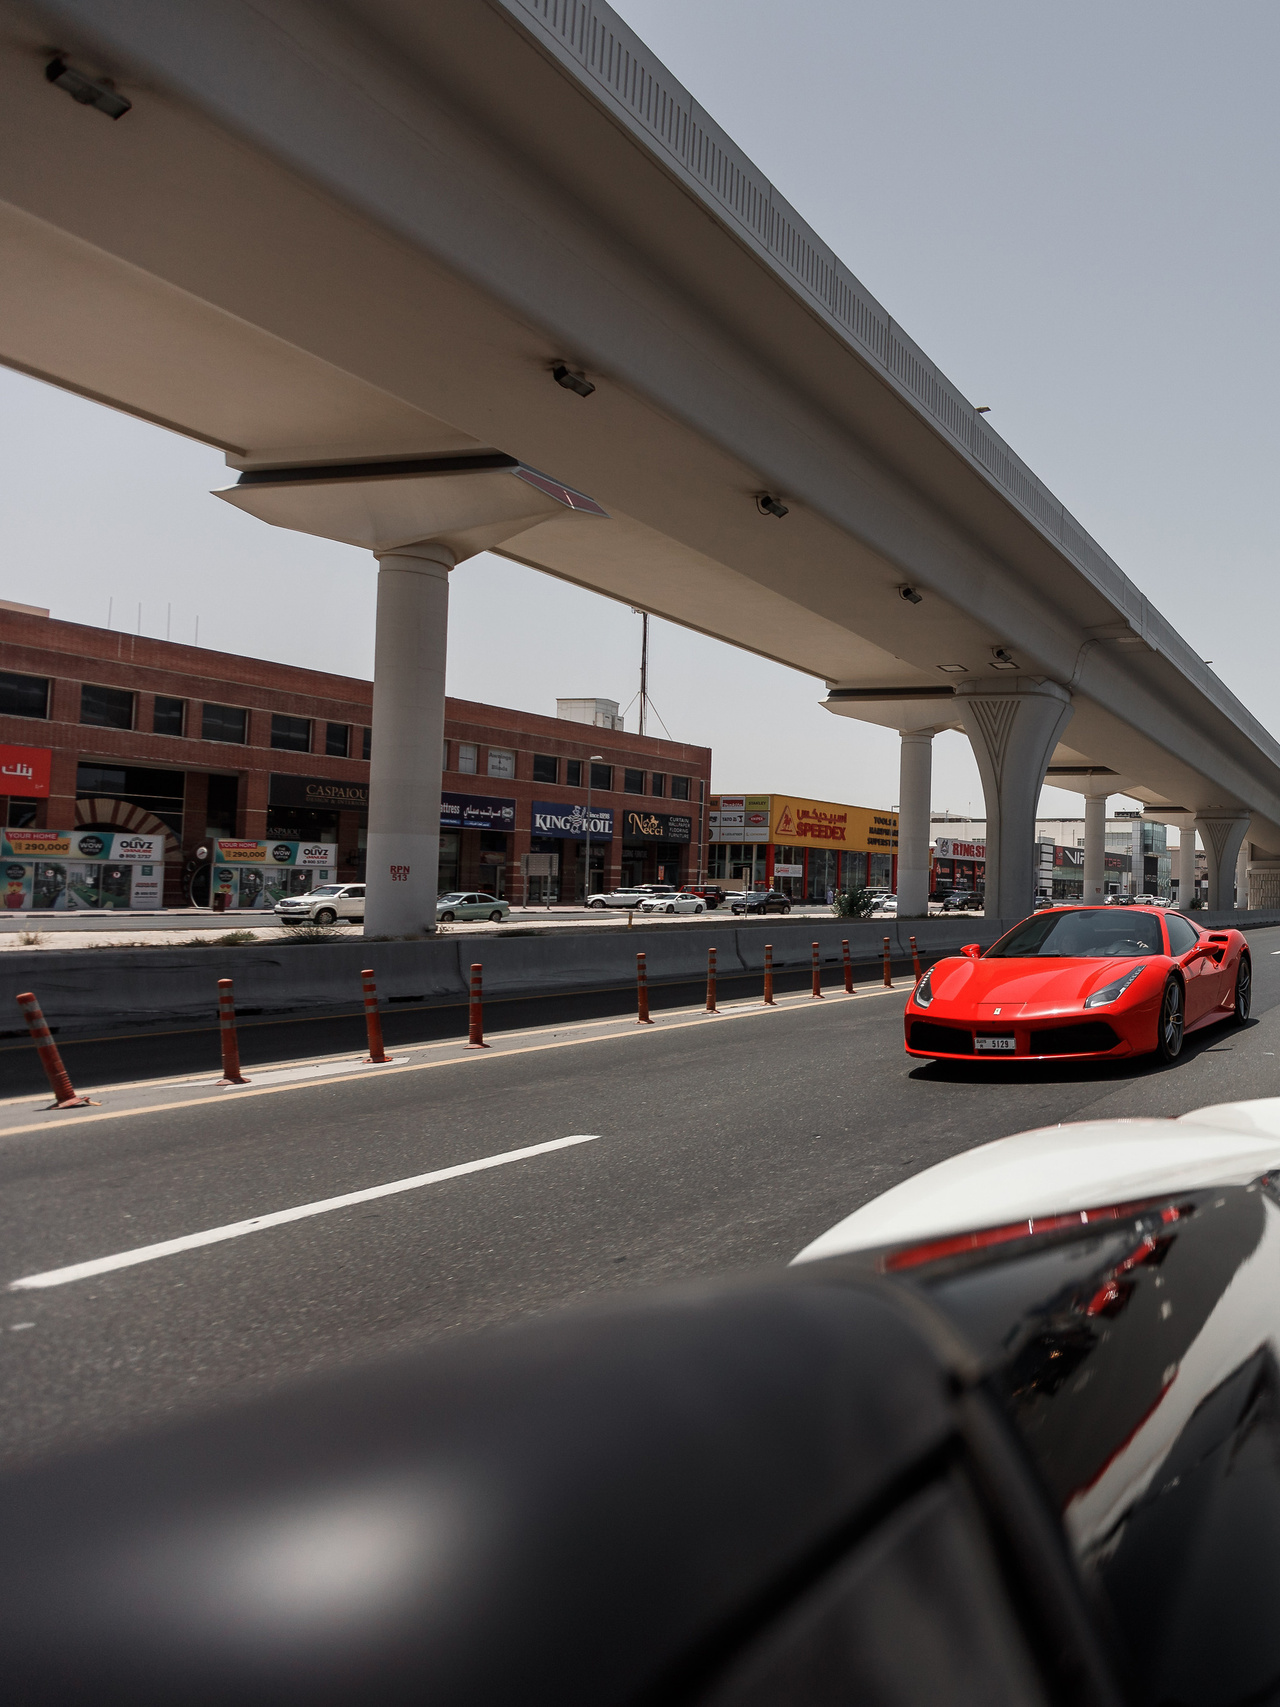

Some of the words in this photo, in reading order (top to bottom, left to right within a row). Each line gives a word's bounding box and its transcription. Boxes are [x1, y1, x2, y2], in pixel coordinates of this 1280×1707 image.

[535, 813, 571, 830] KING
[581, 818, 613, 833] KOIL
[873, 816, 892, 827] TOOLS
[893, 819, 897, 827] &
[795, 821, 847, 840] SPEEDEX
[120, 840, 153, 849] OLIVZ
[952, 842, 975, 857] RING
[303, 848, 328, 856] OLIVZ
[390, 865, 410, 873] RPN
[992, 1040, 1009, 1048] 5129
